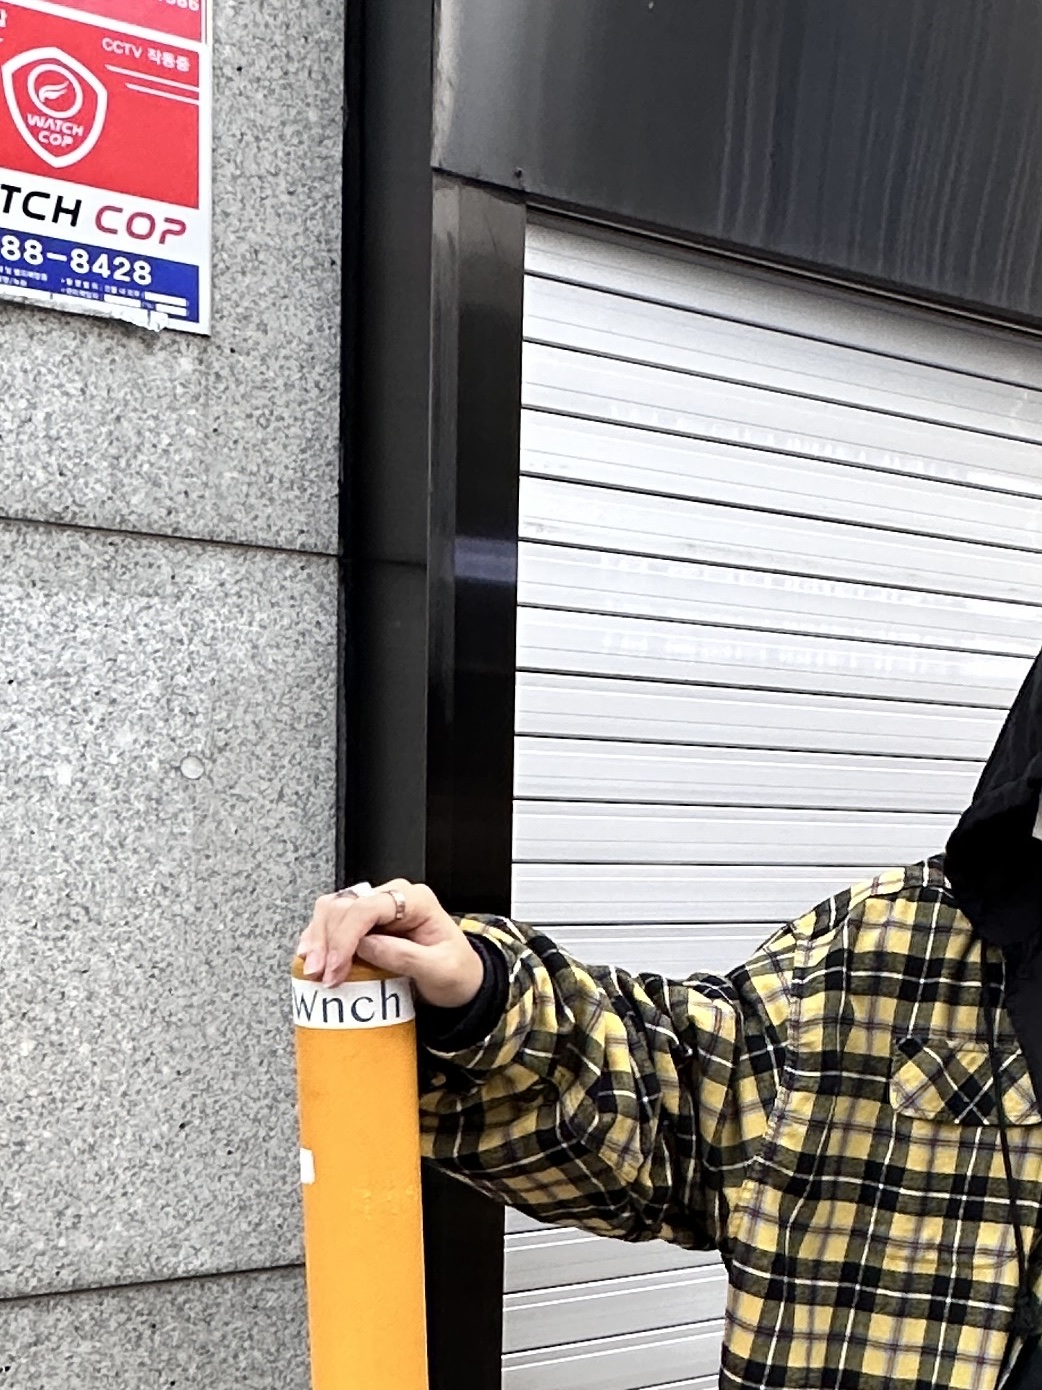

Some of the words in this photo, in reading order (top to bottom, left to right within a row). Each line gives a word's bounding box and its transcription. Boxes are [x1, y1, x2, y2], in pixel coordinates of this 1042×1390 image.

[102, 37, 142, 59] CCTV
[27, 113, 84, 137] WATCH
[38, 132, 73, 148] COP
[95, 205, 187, 244] COP
[0, 235, 151, 286] 88-8428
